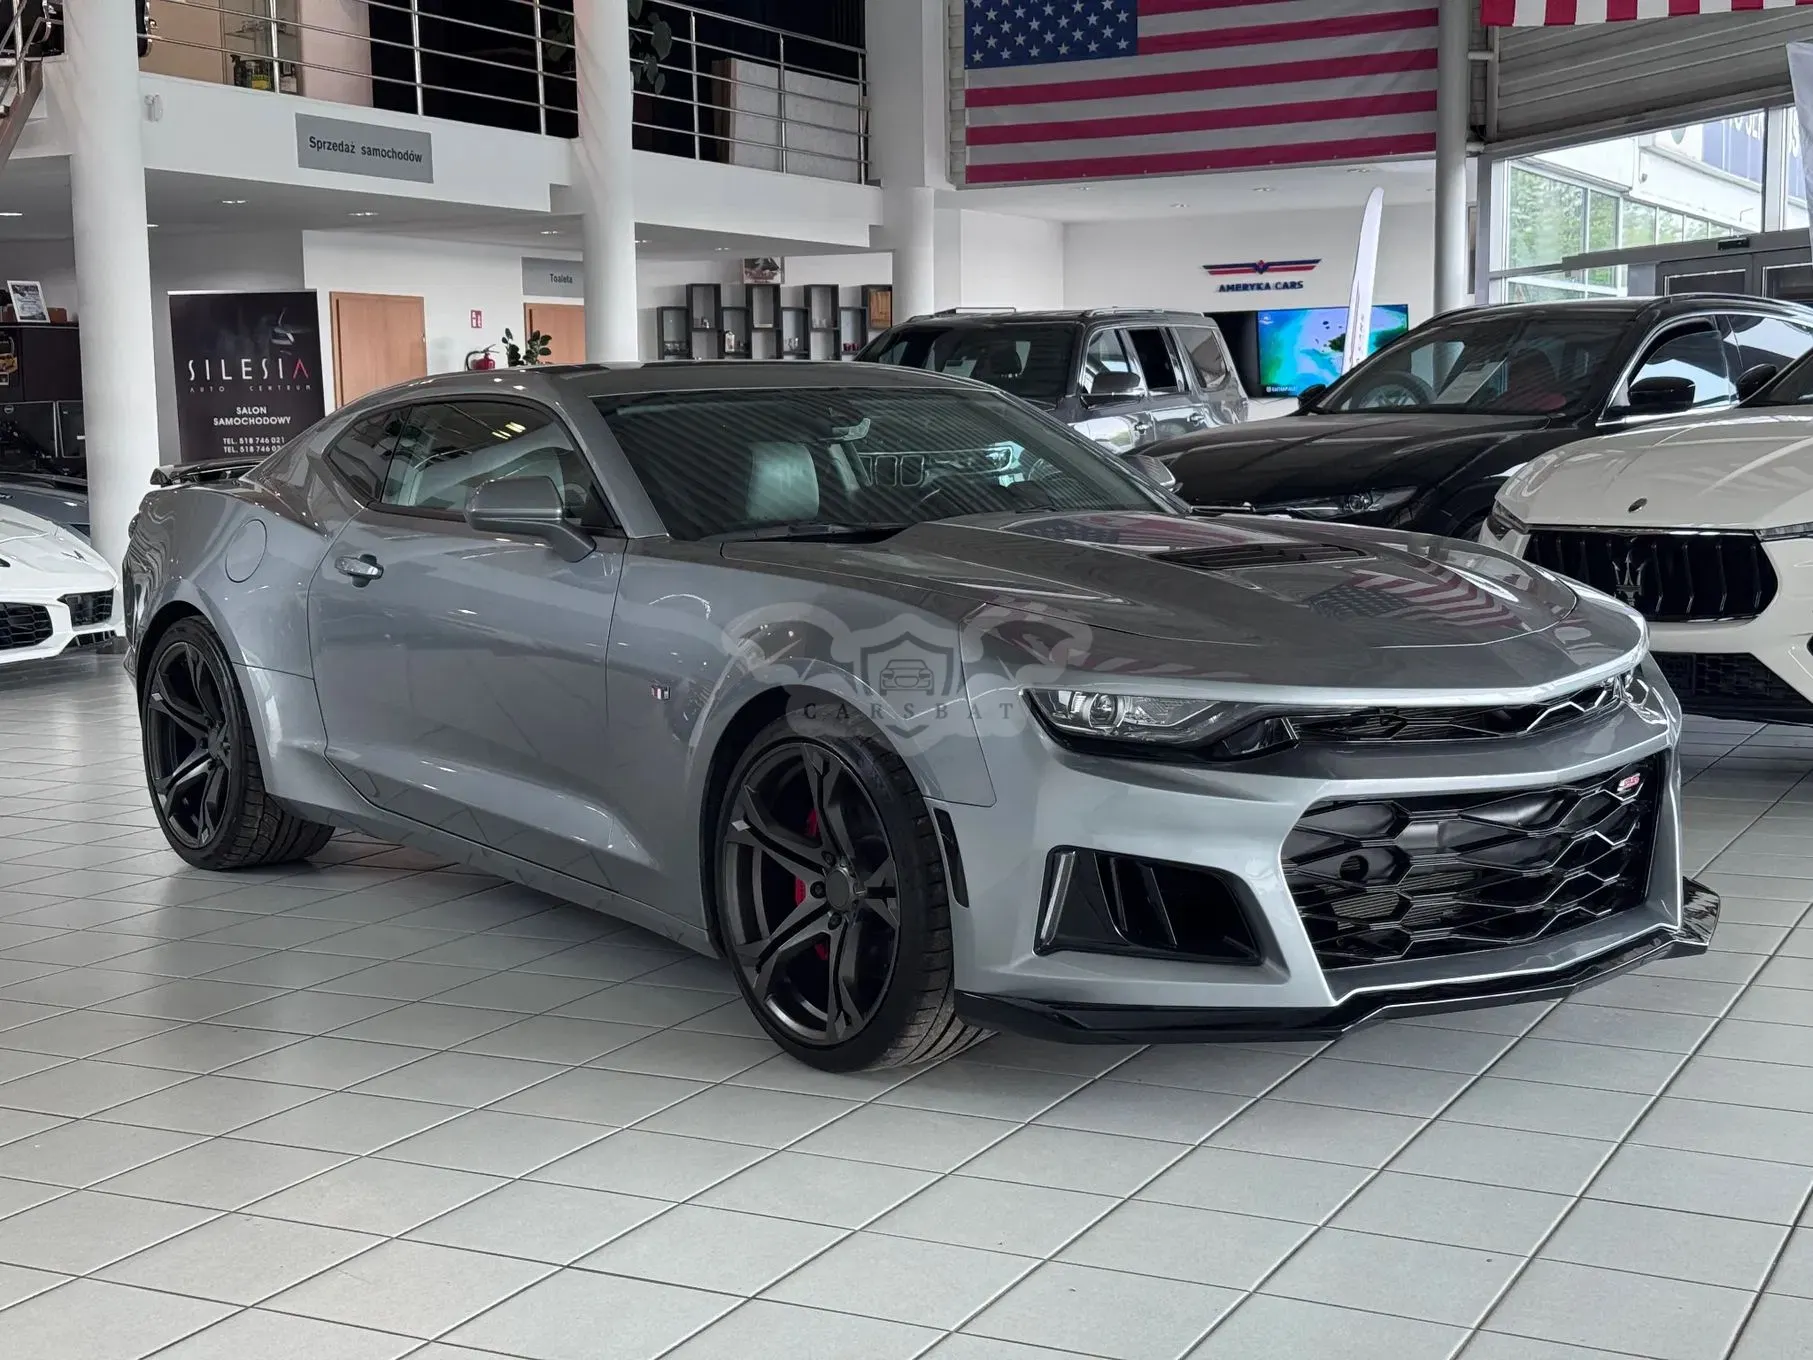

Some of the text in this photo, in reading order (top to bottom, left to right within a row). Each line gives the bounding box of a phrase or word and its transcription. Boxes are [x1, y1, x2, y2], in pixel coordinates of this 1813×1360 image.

[308, 135, 423, 163] Sprzedaż samochodów
[550, 273, 573, 285] Toaleta
[1218, 280, 1304, 293] AMERYKA CARS
[188, 358, 309, 381] SILESIA
[189, 384, 311, 393] AUTO CENTRUM
[236, 406, 267, 415] SALON
[213, 416, 291, 426] SAMOCHODOWY
[222, 436, 285, 445] TEL. 518 746 021
[223, 446, 239, 454] TEL.
[239, 445, 255, 453] 518
[256, 445, 271, 453] 746
